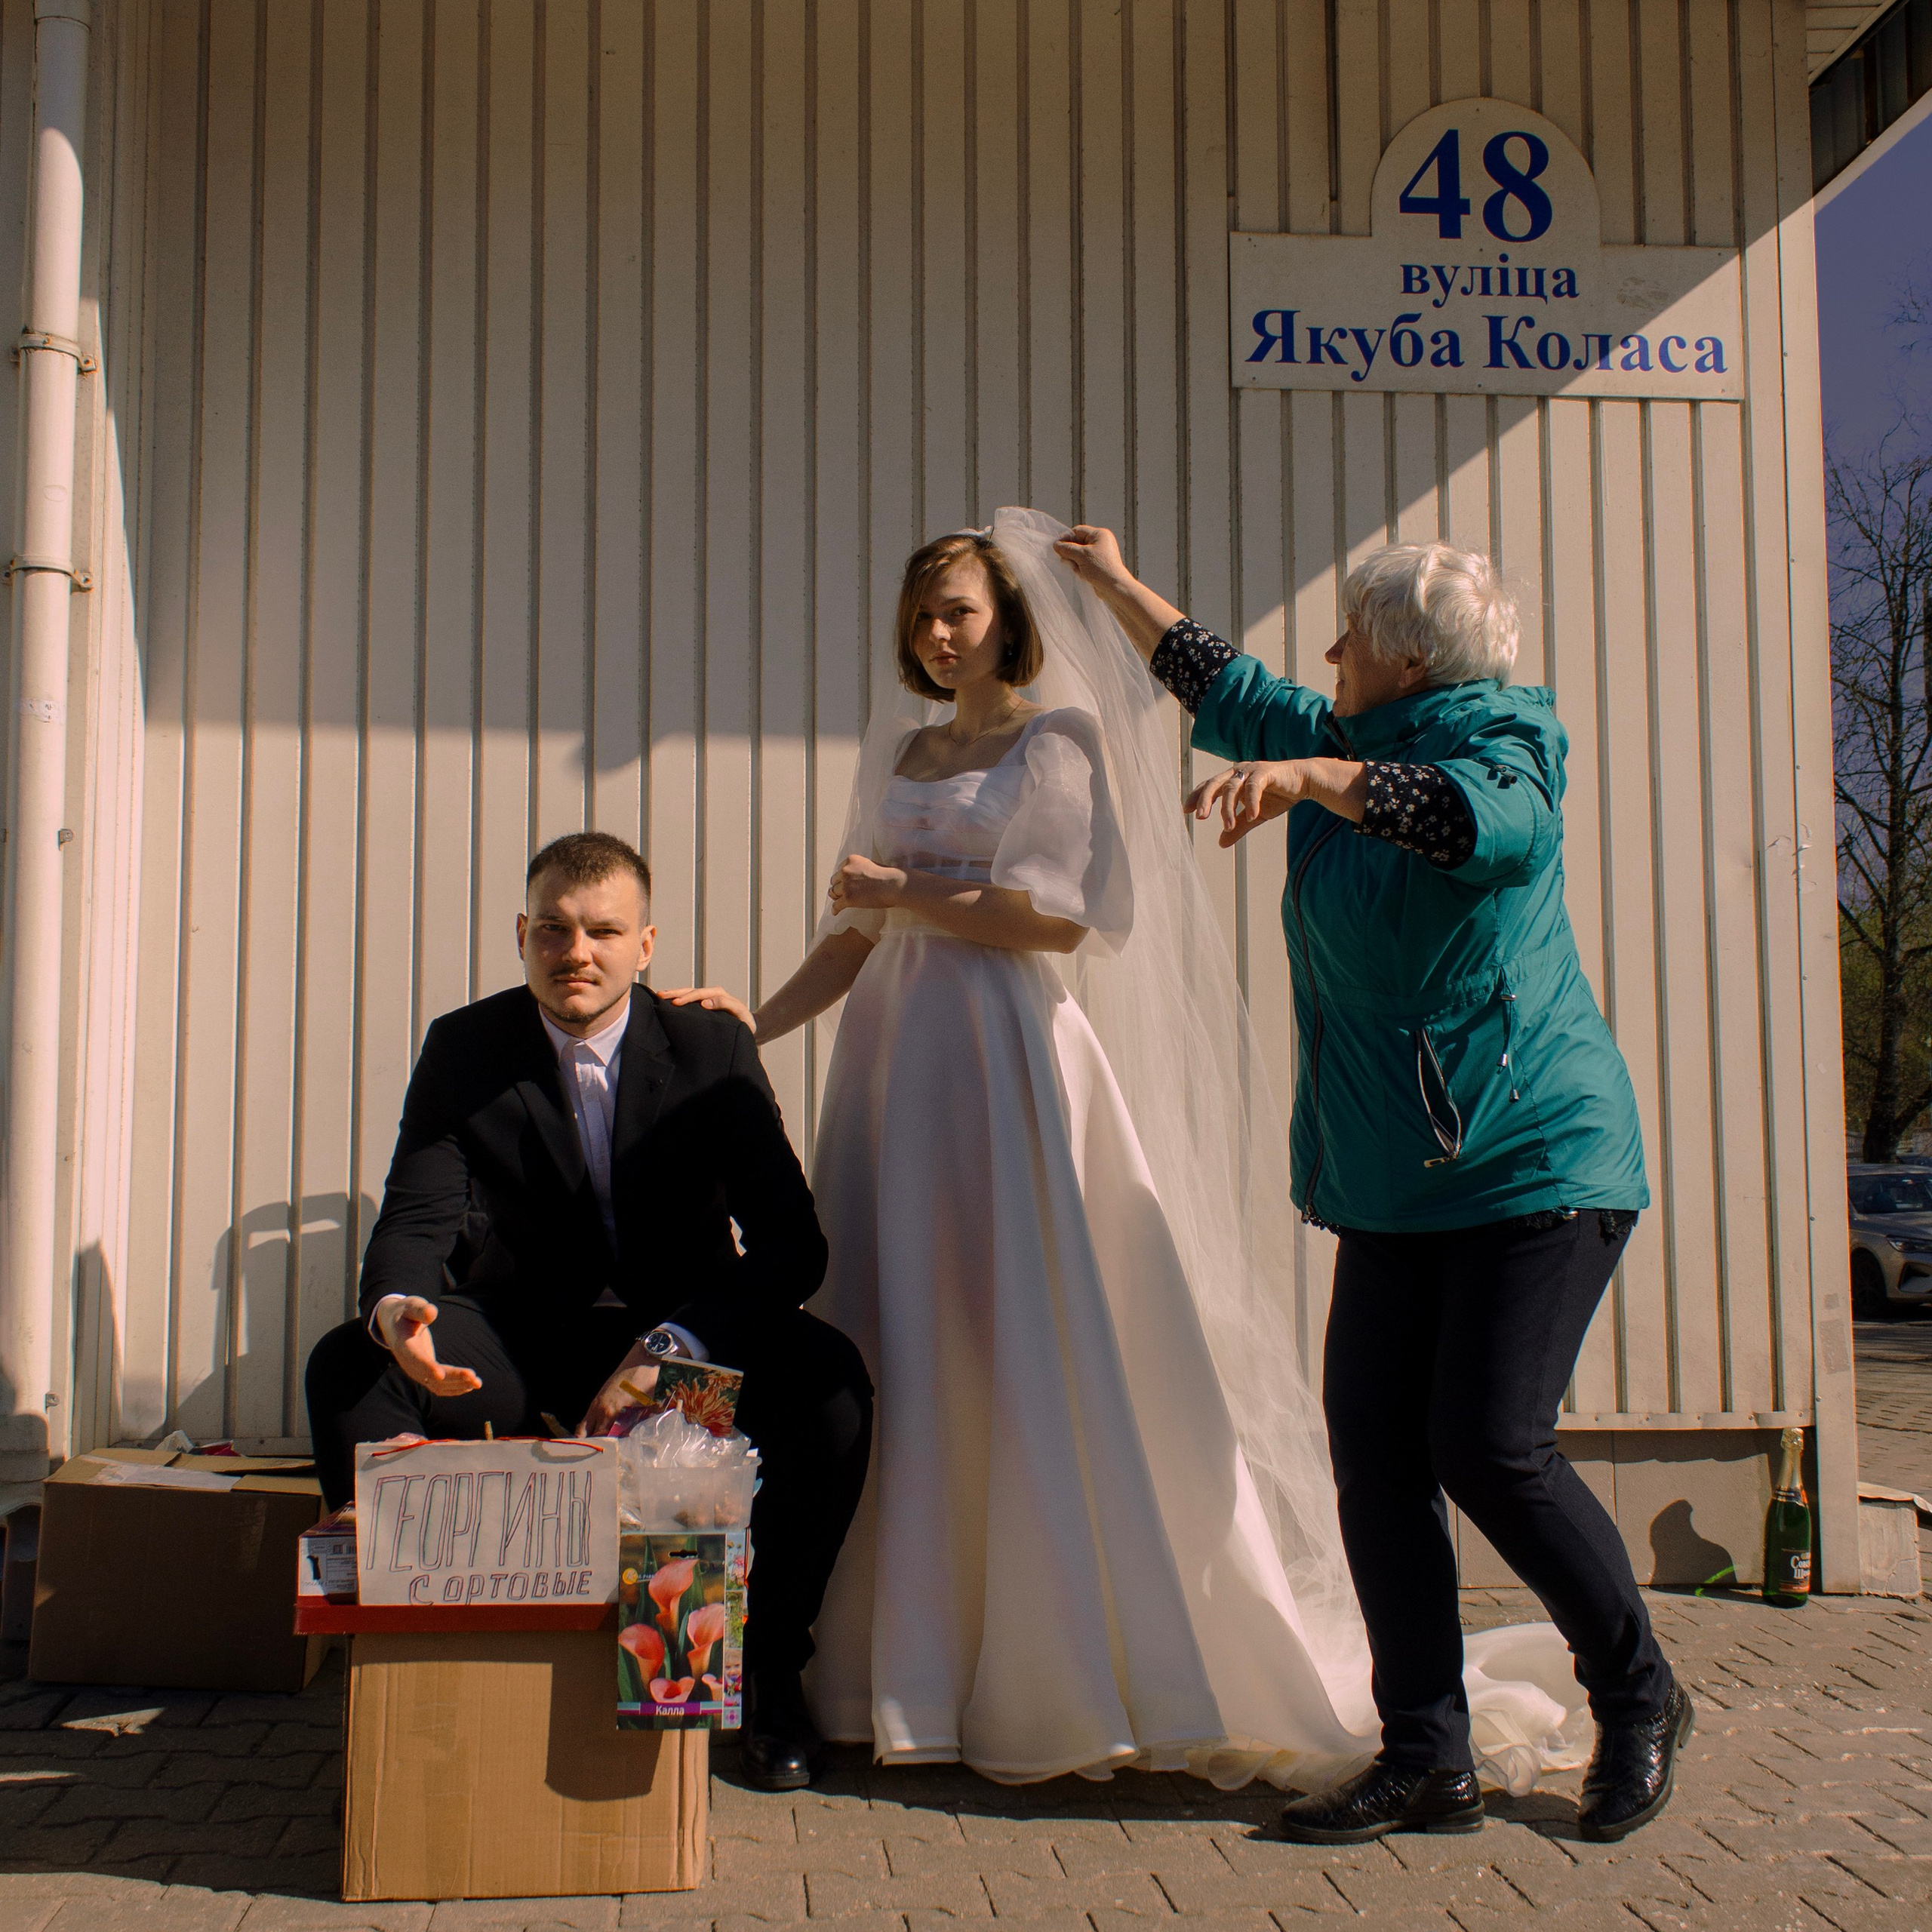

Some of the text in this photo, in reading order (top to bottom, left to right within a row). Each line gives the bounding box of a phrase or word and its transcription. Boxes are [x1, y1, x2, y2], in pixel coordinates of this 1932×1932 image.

[1399, 128, 1553, 242] 48
[1401, 253, 1580, 308] вуліца
[1245, 309, 1728, 382] Якуба Коласа
[365, 1471, 592, 1572] ГЕОРГИНЫ
[655, 1705, 685, 1715] Калла
